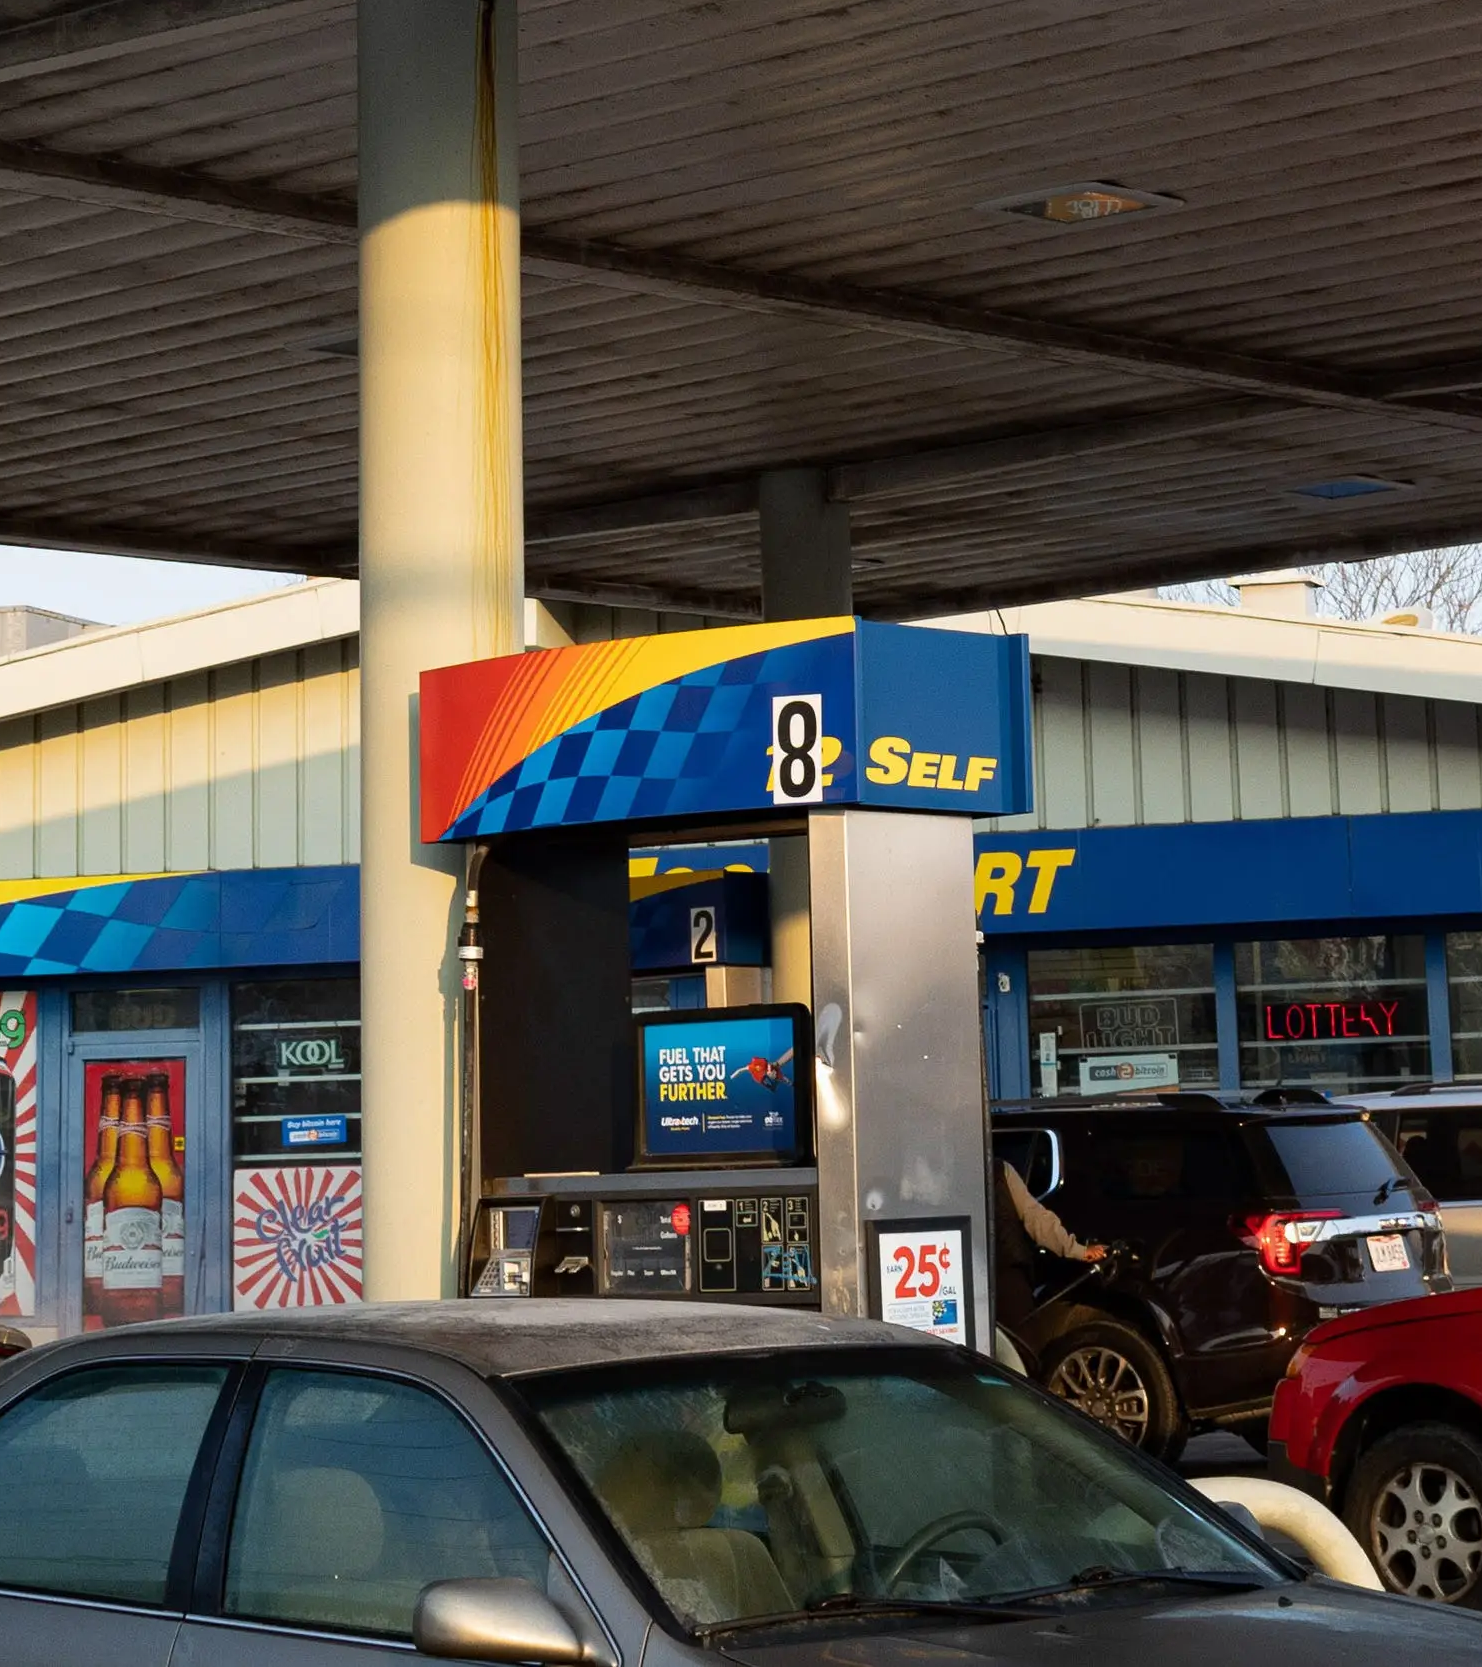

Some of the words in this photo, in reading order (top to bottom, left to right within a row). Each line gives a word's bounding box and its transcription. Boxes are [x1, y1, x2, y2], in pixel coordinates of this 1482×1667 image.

[777, 700, 817, 798] 8
[865, 736, 998, 792] SELF
[692, 909, 715, 961] 2
[280, 1040, 344, 1066] KOOL
[659, 1048, 689, 1065] FUEL
[693, 1046, 726, 1062] THAT
[659, 1066, 693, 1082] GETS
[697, 1064, 726, 1081] YOU
[256, 1196, 345, 1242] Clear
[105, 1256, 161, 1271] Budweiser
[277, 1218, 348, 1283] fruit
[887, 1265, 903, 1274] EARN
[893, 1242, 951, 1299] 25¢
